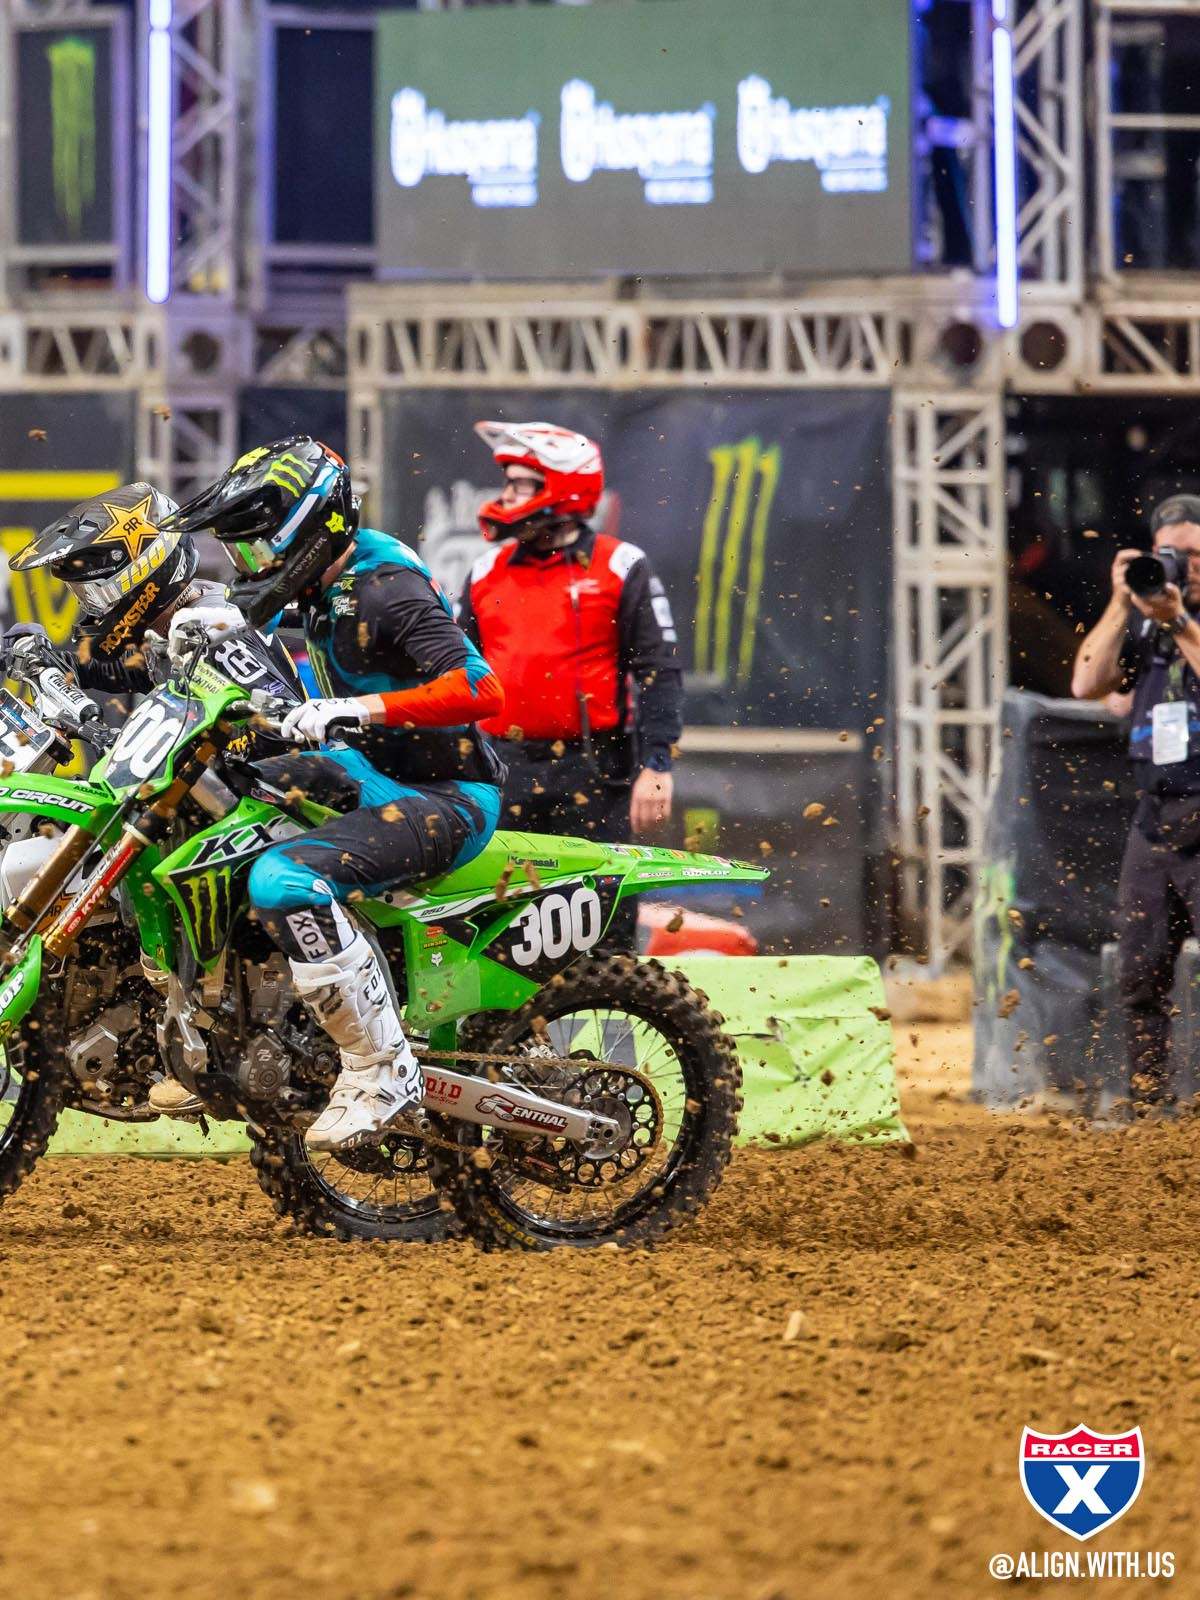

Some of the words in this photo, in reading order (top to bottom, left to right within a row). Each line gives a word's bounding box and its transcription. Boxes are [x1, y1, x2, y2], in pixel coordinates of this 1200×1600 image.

[99, 582, 161, 656] ROCKSTAR
[10, 788, 96, 814] CIRCUIT
[189, 814, 288, 867] KX
[293, 916, 327, 960] FOX
[508, 887, 601, 967] 300
[475, 1094, 568, 1128] RENTHAL
